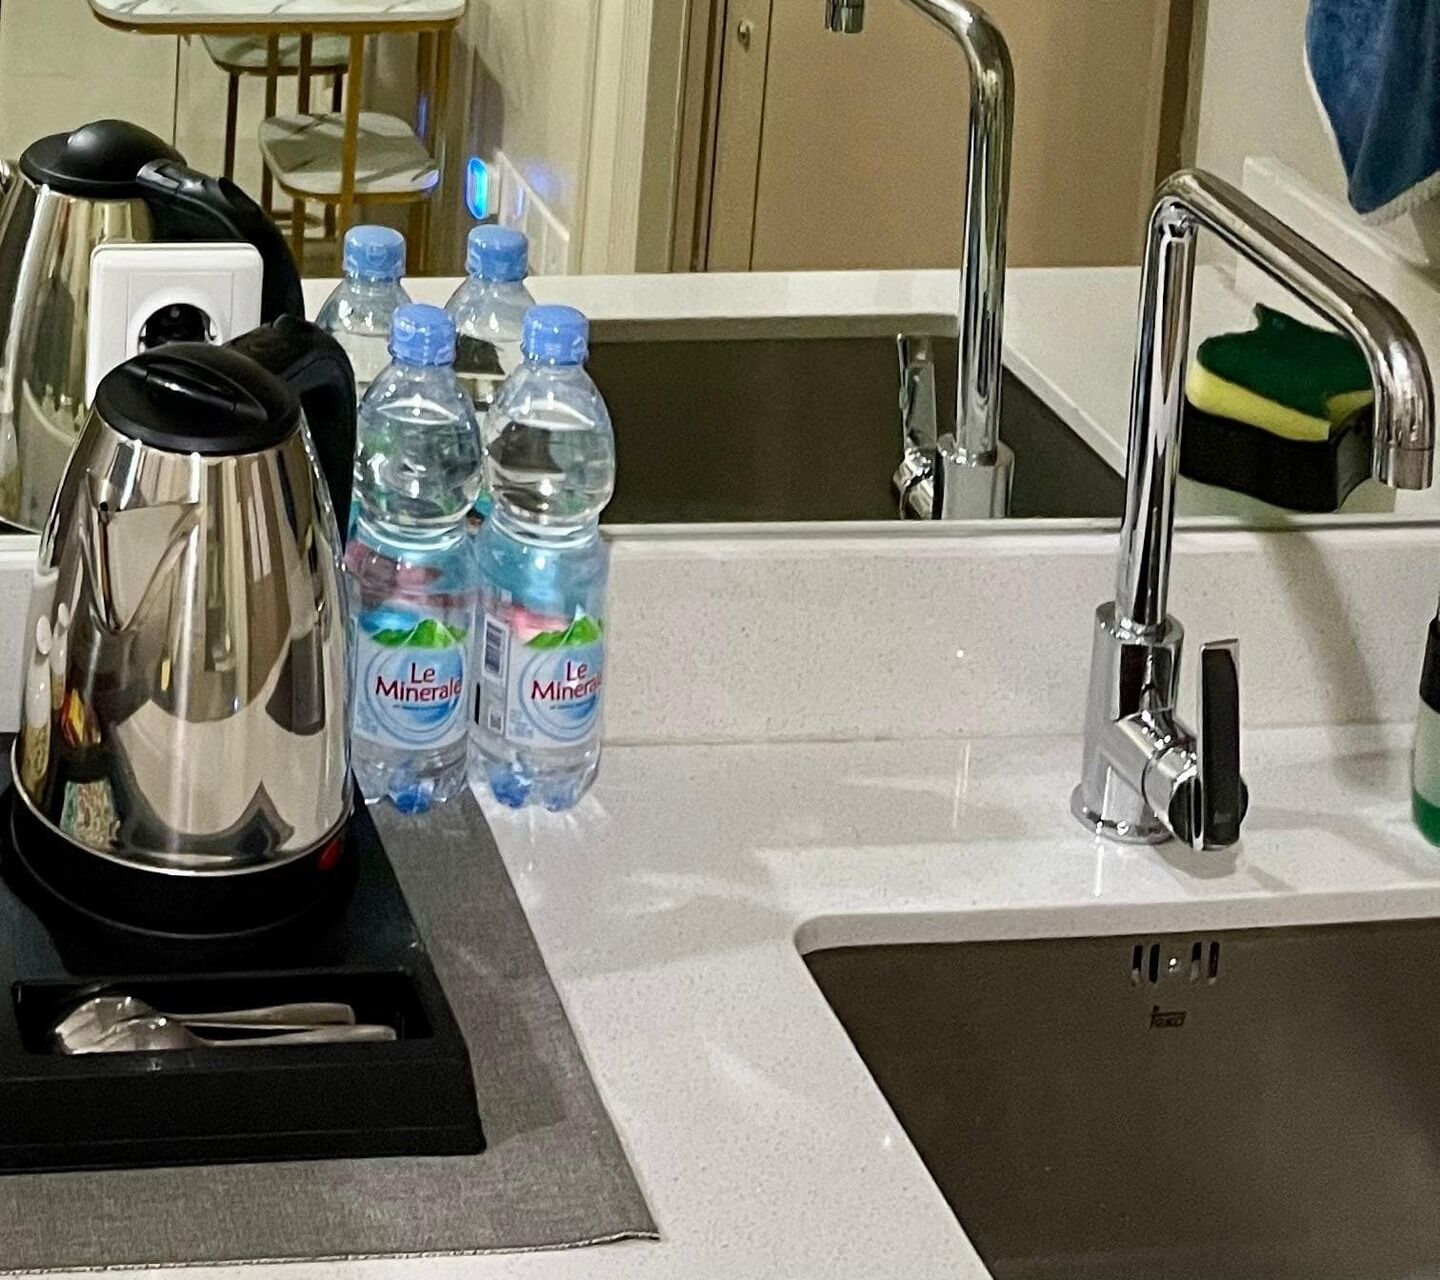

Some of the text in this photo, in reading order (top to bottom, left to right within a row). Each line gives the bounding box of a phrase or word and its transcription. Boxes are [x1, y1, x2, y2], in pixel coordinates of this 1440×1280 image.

[411, 662, 436, 684] Le
[567, 660, 587, 682] Le
[531, 672, 603, 701] Minera
